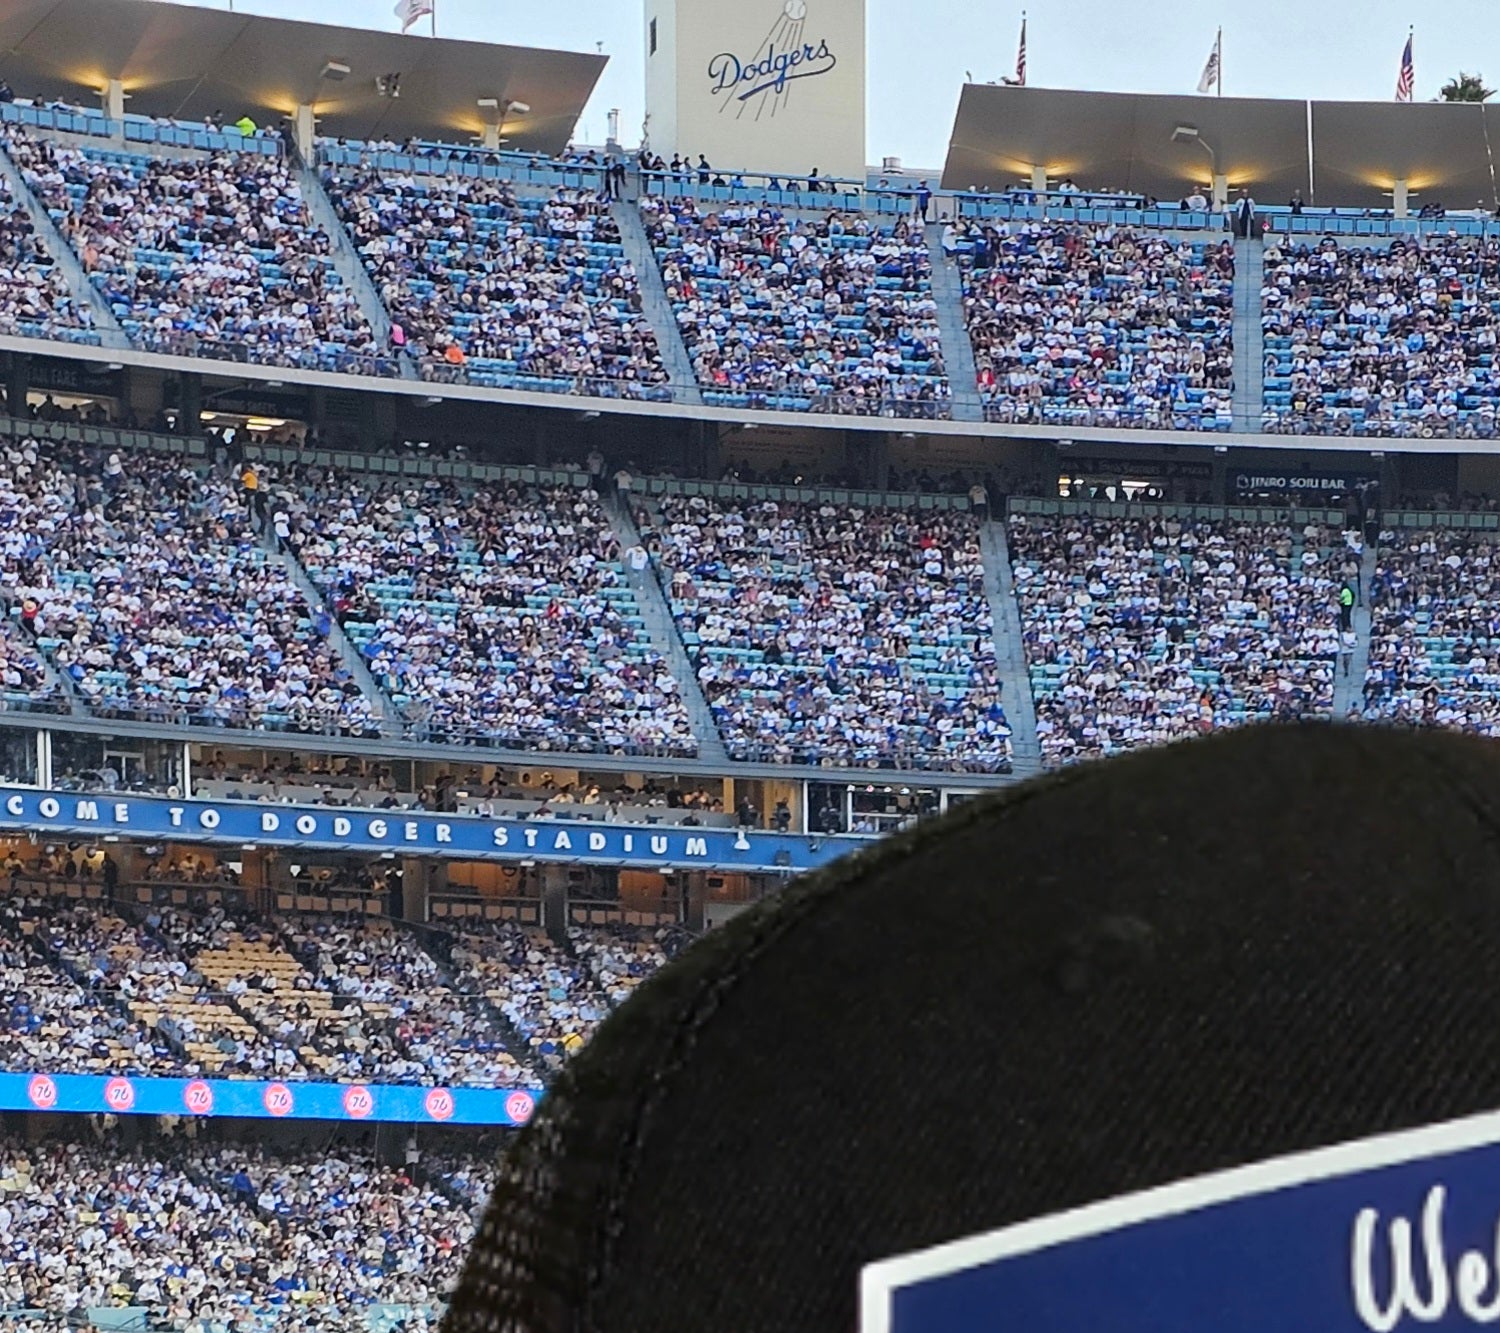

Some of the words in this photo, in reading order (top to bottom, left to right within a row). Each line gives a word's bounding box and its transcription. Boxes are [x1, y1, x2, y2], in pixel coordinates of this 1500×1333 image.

[708, 39, 836, 101] Dodgers
[1321, 479, 1347, 490] BAR
[8, 796, 129, 821] COME
[169, 807, 220, 828] TO
[262, 813, 451, 842] DODGER
[494, 827, 707, 856] STADIUM
